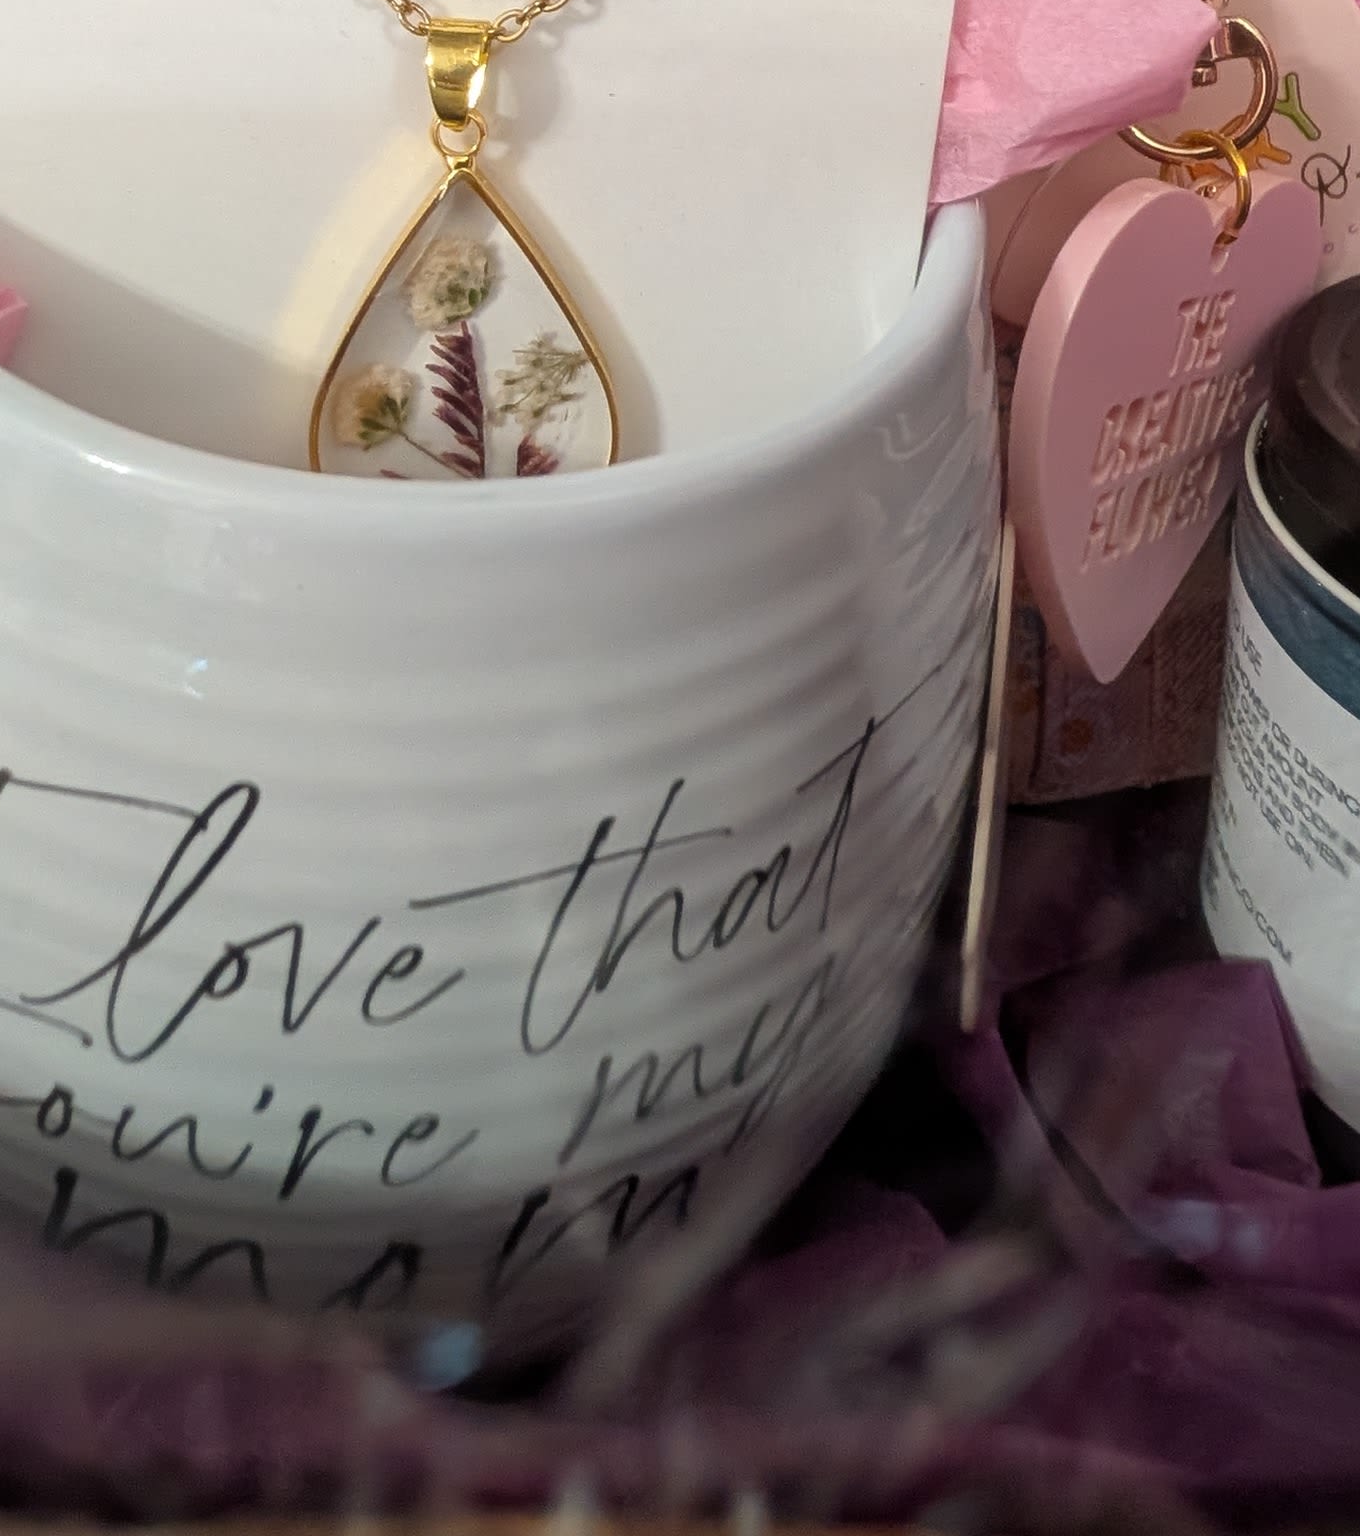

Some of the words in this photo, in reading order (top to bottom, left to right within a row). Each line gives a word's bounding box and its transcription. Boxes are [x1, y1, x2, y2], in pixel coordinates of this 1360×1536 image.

[1169, 288, 1237, 378] THE
[19, 780, 464, 1061] love
[408, 654, 958, 1056] that
[557, 951, 836, 1166] my
